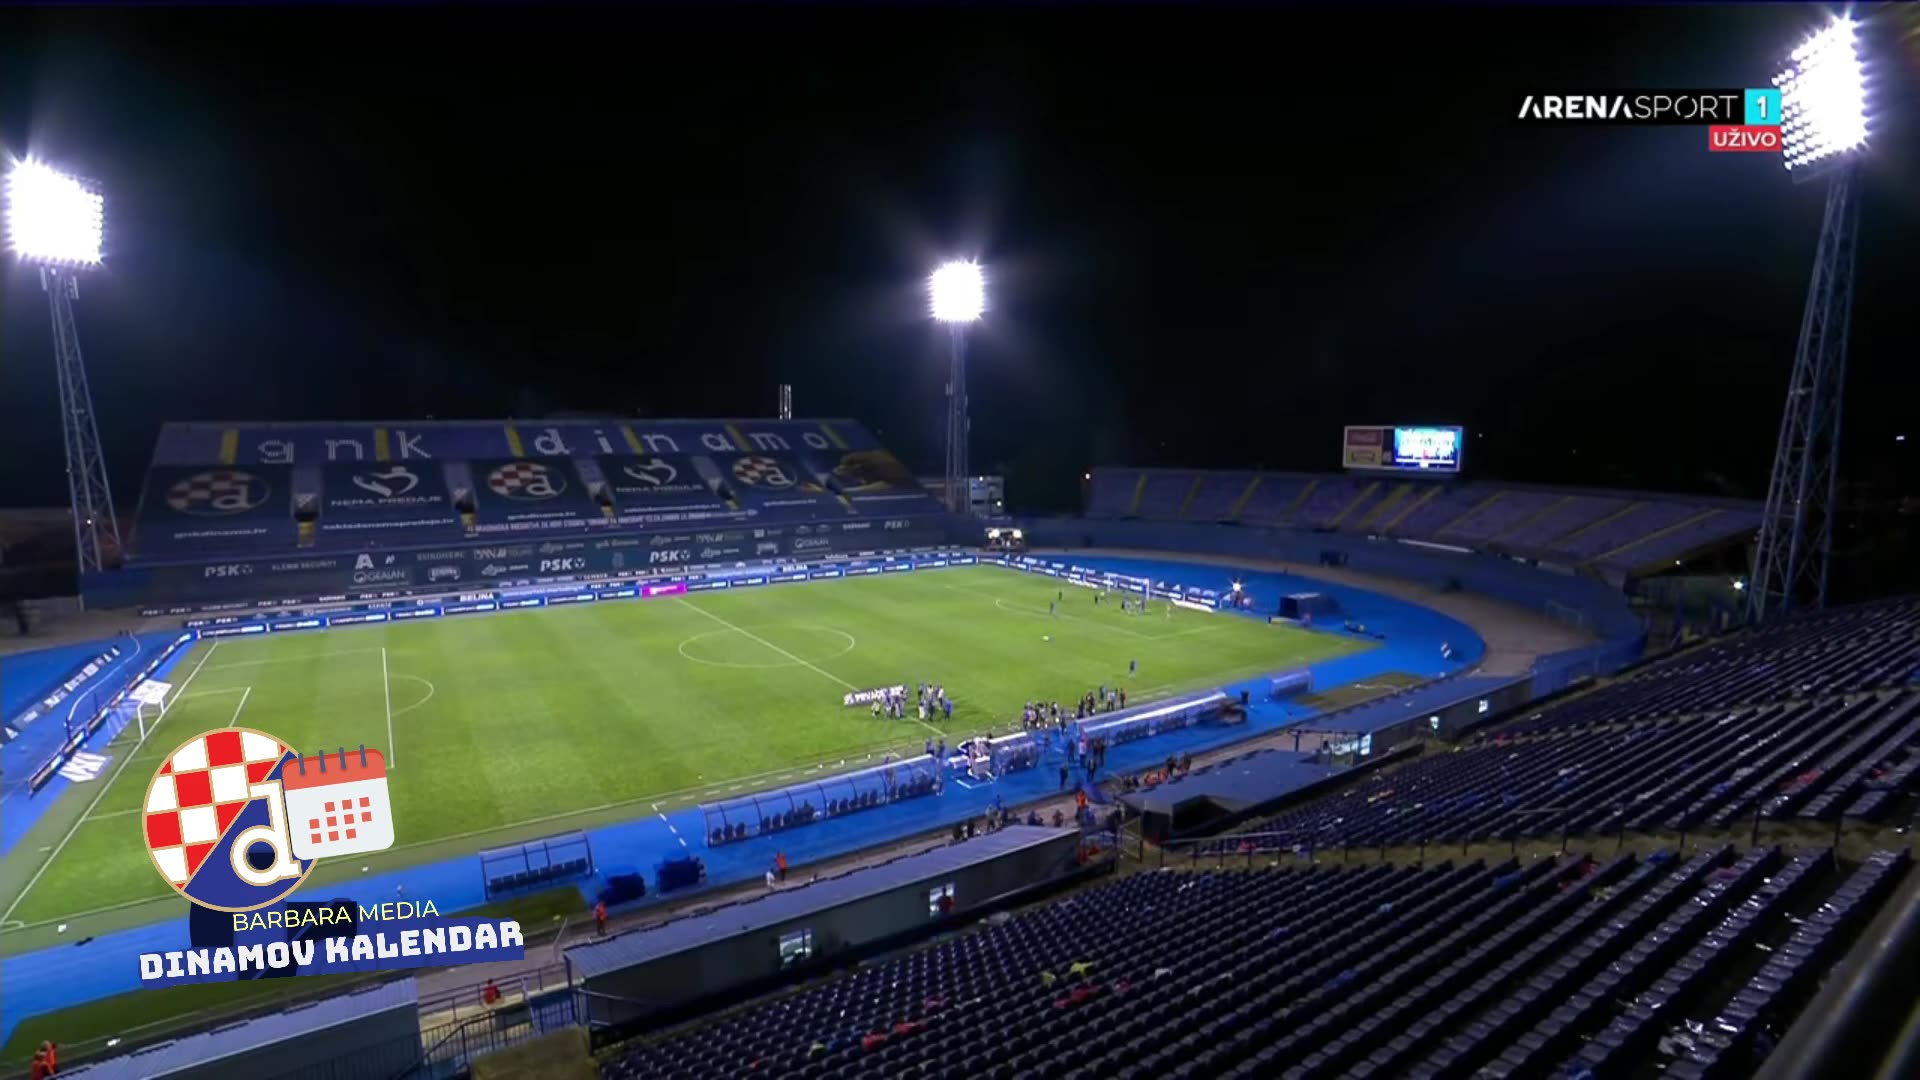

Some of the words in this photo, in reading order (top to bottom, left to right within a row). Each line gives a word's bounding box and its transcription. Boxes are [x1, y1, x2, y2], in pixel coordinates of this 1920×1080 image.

[257, 430, 432, 465] gnk
[532, 428, 830, 456] dinamo
[650, 550, 679, 563] PSK
[204, 563, 240, 578] PSK
[540, 558, 572, 573] PSK
